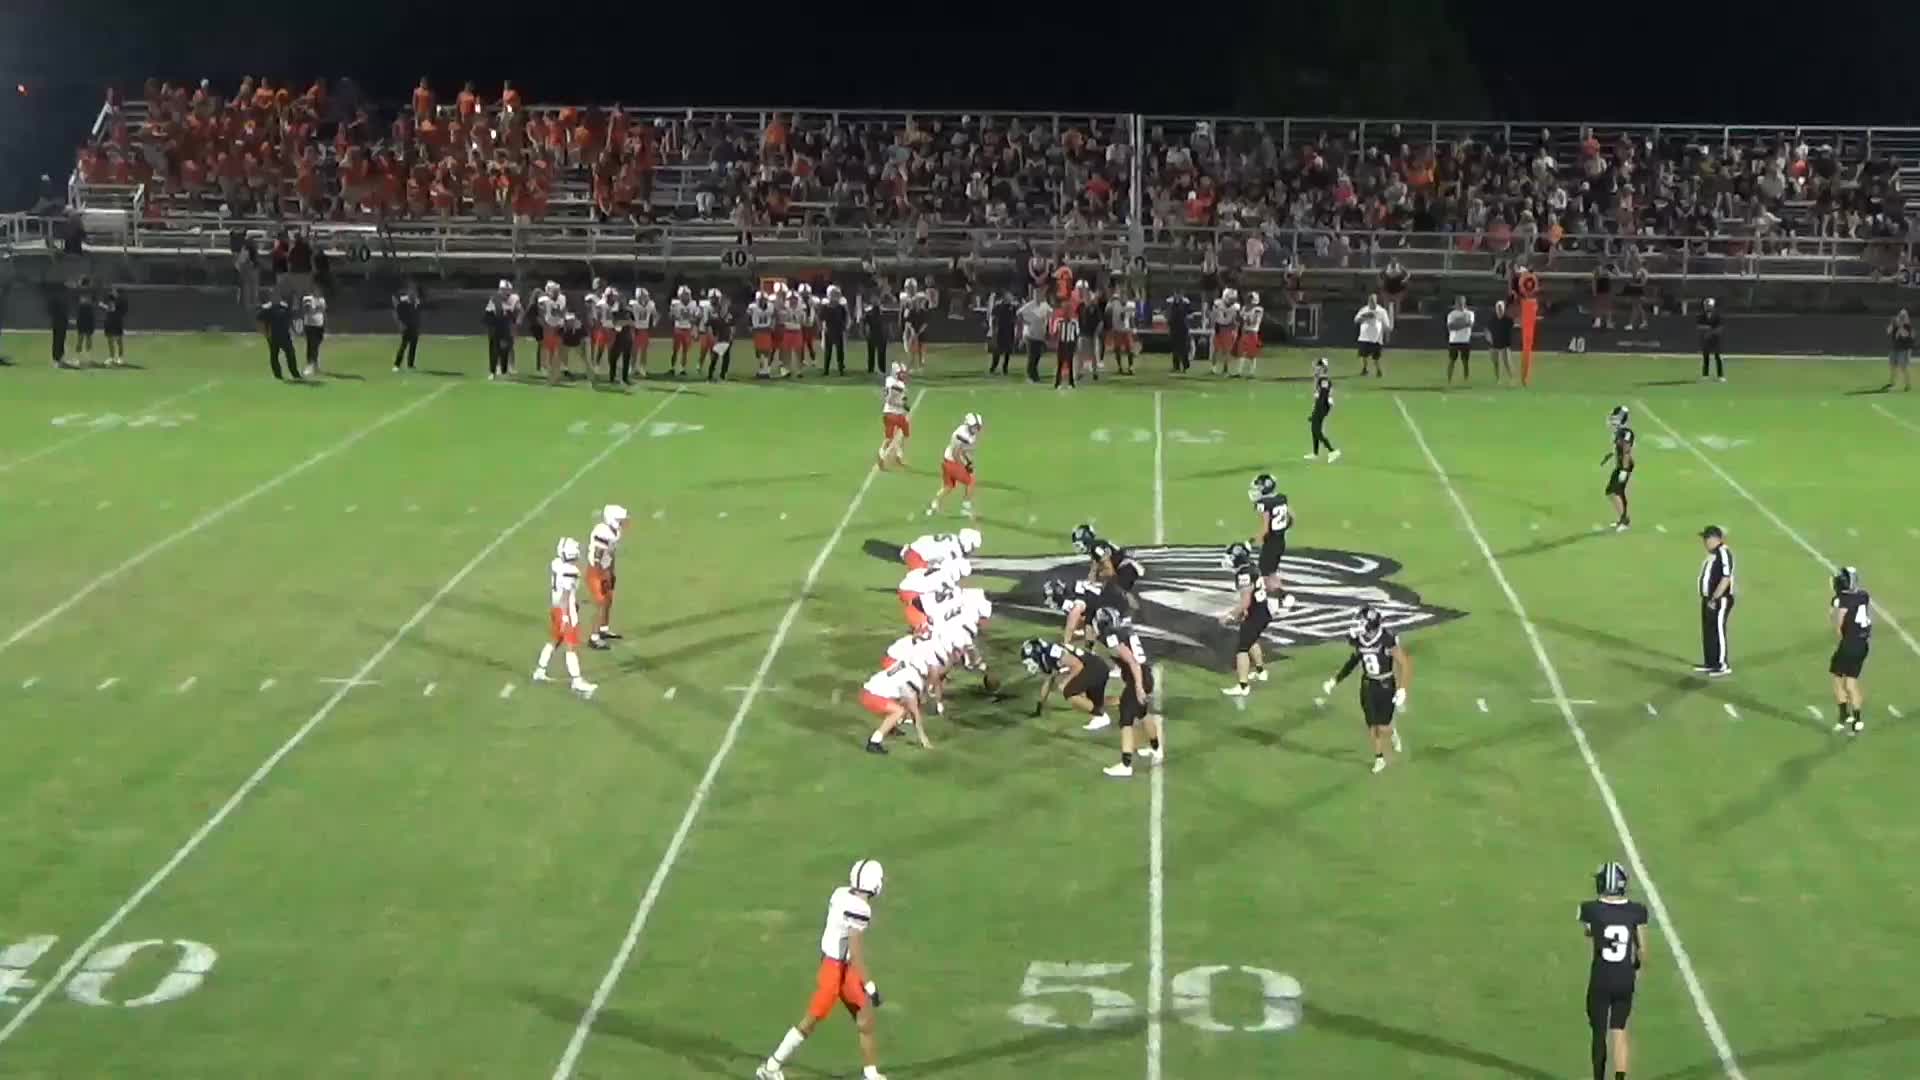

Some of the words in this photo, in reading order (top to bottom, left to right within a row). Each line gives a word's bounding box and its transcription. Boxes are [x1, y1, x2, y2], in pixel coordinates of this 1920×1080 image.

[721, 250, 747, 267] 40
[1568, 336, 1586, 353] 40
[1601, 924, 1630, 963] 3
[1006, 961, 1304, 1031] 50
